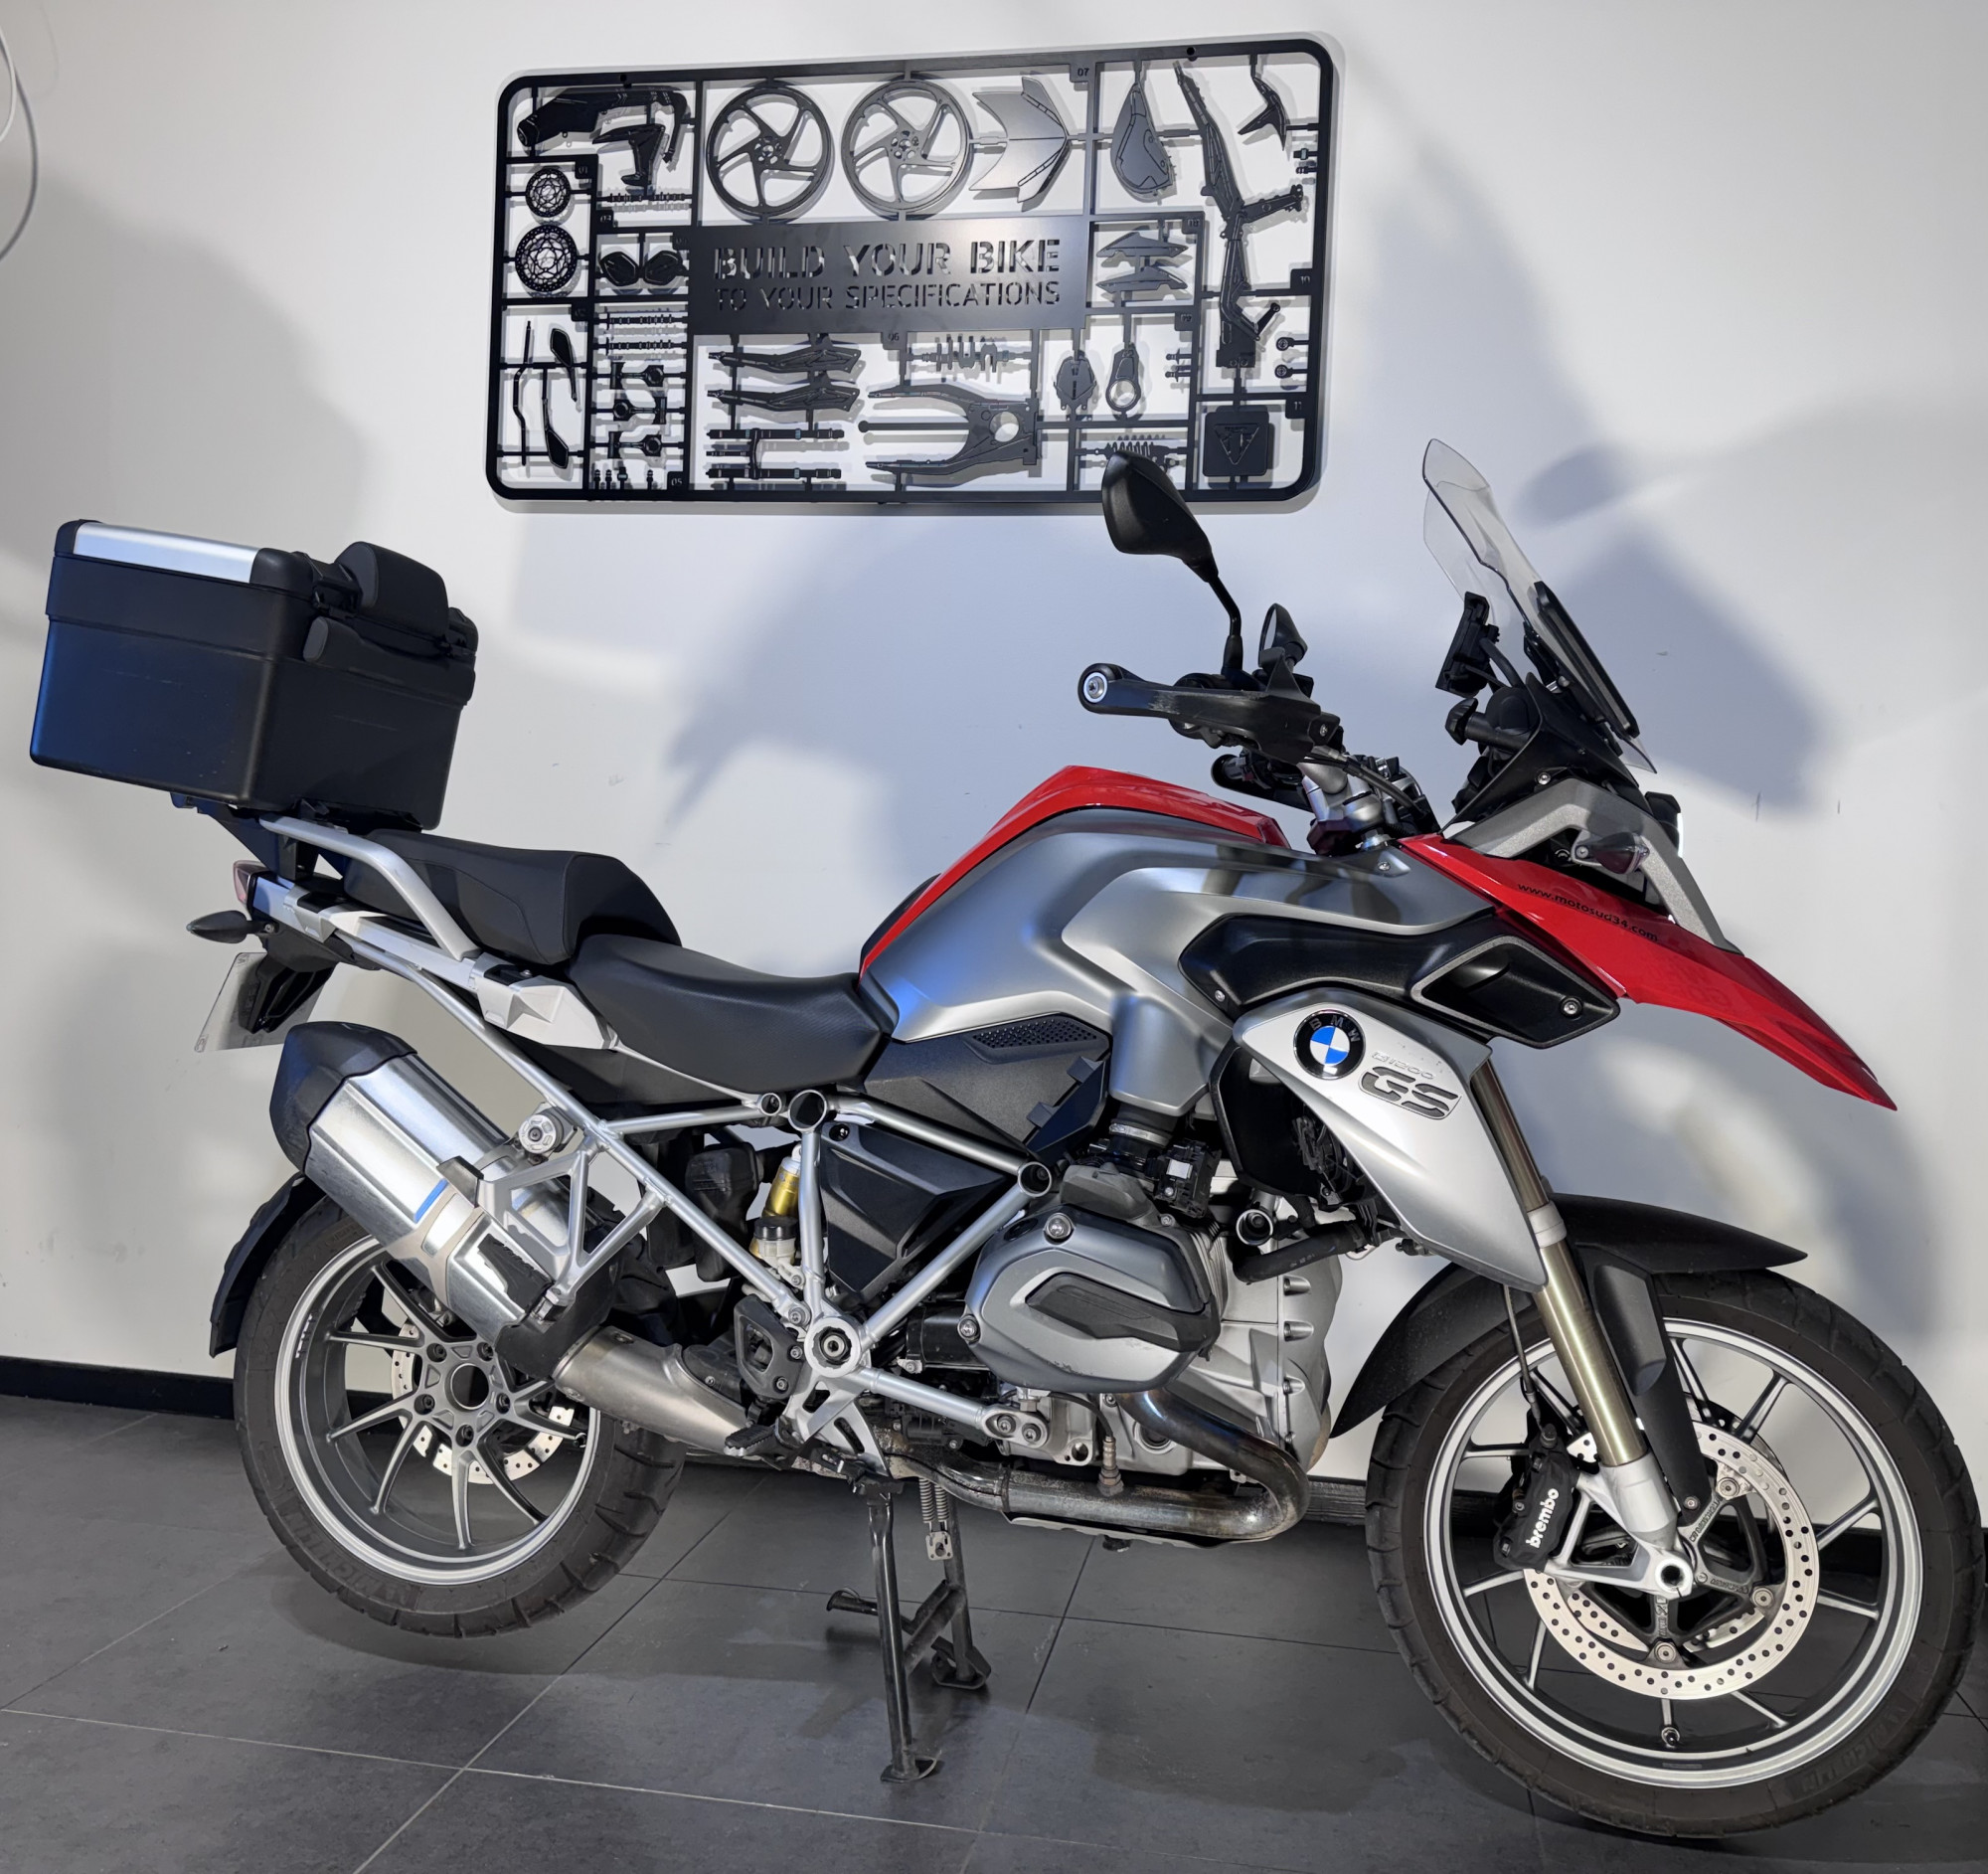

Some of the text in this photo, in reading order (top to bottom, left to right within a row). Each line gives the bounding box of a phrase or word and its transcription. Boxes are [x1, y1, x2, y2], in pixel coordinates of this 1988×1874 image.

[1077, 68, 1089, 77] 07
[715, 239, 1061, 279] BUILD YOUR BIKE
[715, 280, 1061, 311] TO YOUR SPECIFICATIONS
[888, 332, 901, 342] 06
[1517, 884, 1658, 941] www.motosud34.com
[1308, 1014, 1361, 1043] BMW
[1361, 1066, 1458, 1118] GS
[1526, 1487, 1560, 1549] brembo
